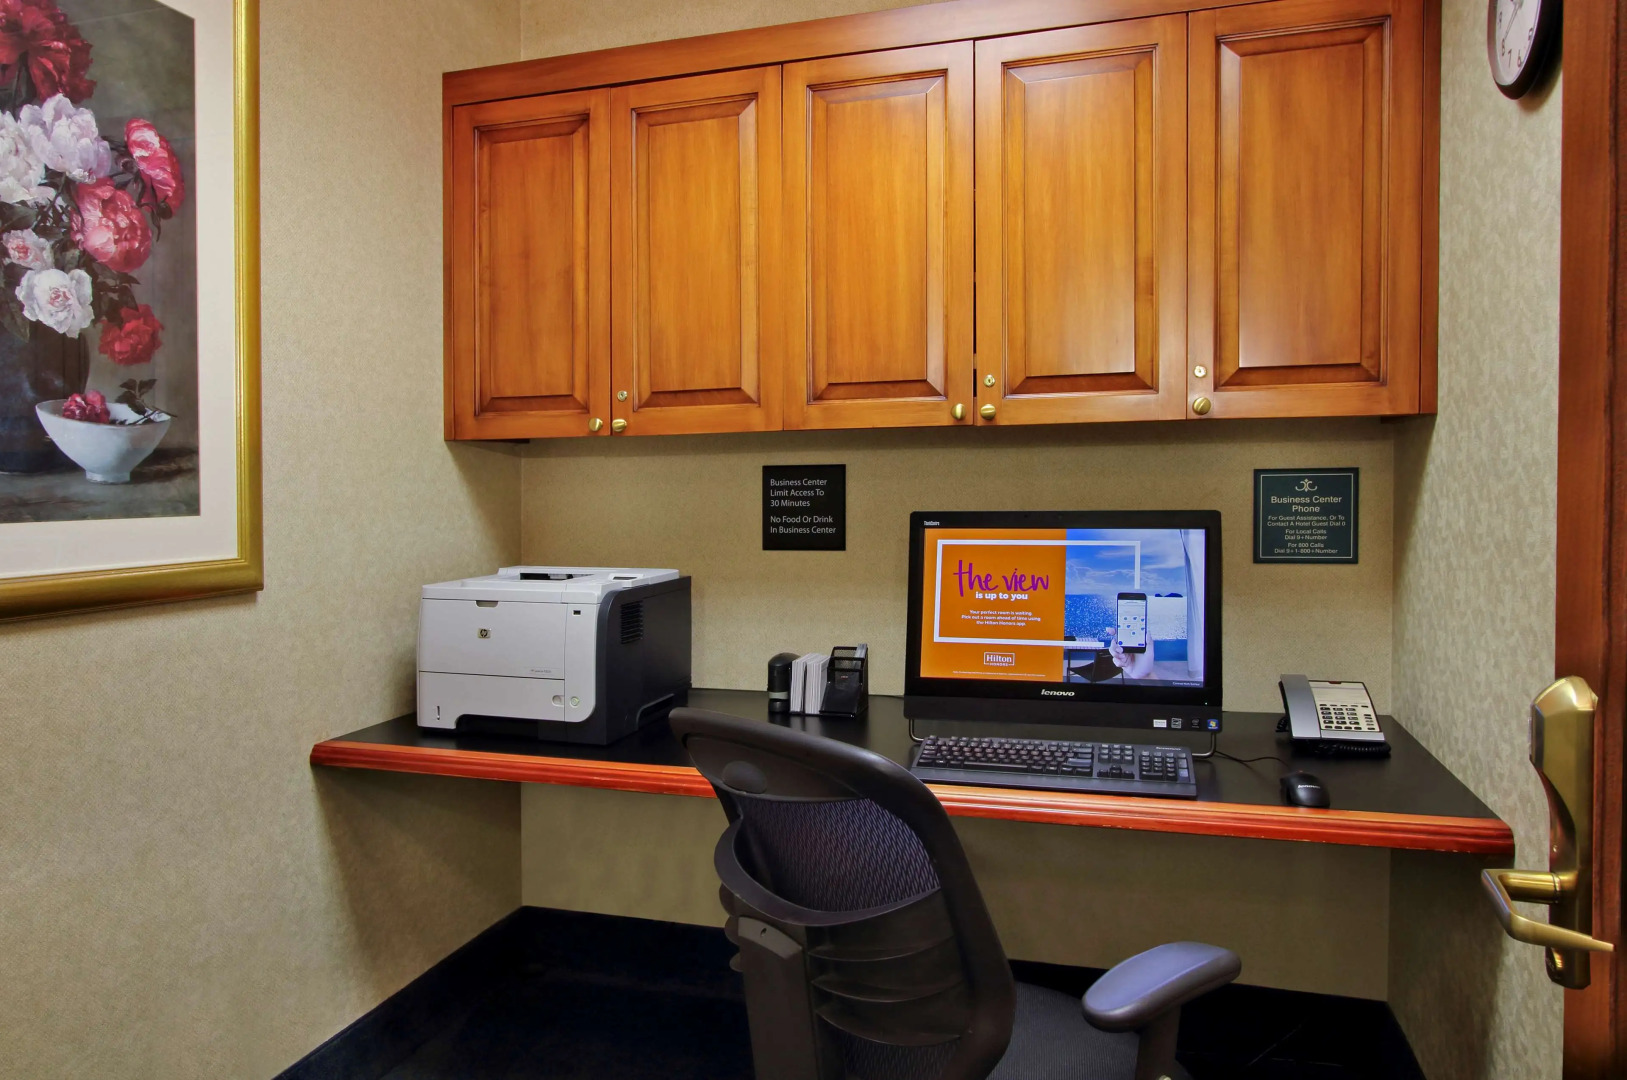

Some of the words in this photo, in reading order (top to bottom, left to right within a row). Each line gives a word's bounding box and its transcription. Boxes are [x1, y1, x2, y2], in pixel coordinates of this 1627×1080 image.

[1508, 48, 1512, 68] 7
[1516, 49, 1522, 68] 6
[770, 478, 801, 486] Business
[953, 560, 999, 597] the
[1002, 568, 1049, 592] view
